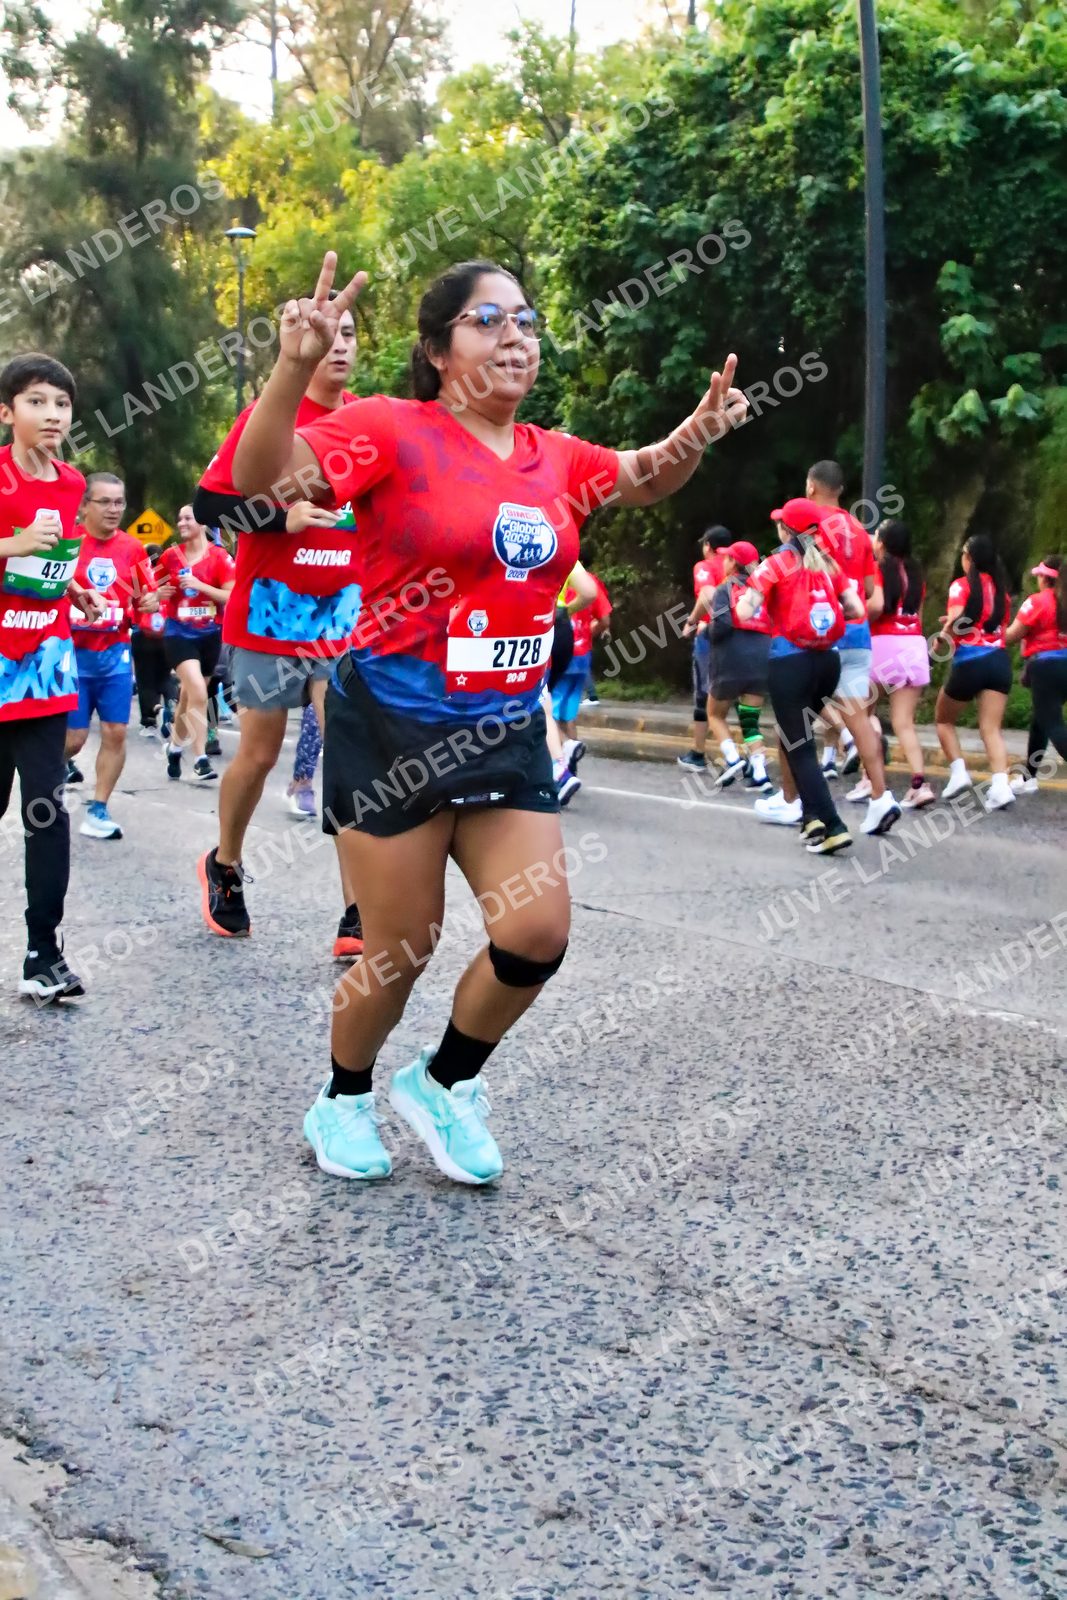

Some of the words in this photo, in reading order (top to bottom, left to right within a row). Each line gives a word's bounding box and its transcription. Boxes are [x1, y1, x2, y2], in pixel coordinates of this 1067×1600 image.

[503, 530, 530, 544] Race
[509, 521, 541, 536] Global
[41, 561, 67, 580] 427
[492, 637, 542, 668] 2728
